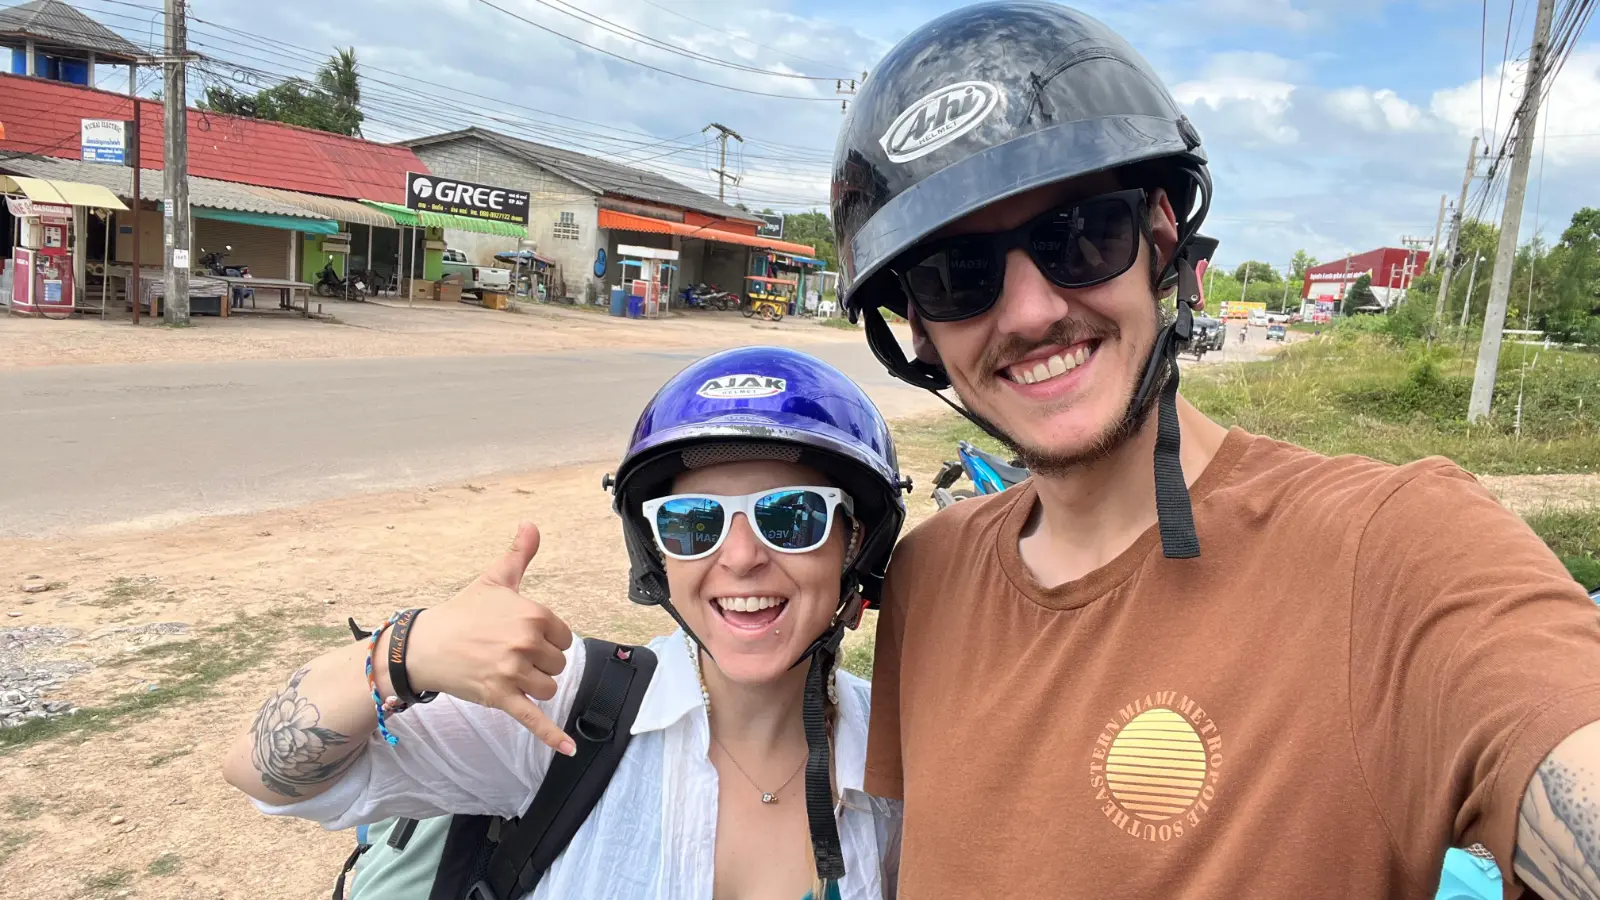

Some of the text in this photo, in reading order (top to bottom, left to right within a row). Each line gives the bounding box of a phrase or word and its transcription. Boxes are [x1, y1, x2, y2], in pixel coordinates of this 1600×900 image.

[101, 121, 122, 133] ELECTRIC
[919, 121, 957, 145] HELMET
[435, 181, 506, 210] GREE
[32, 204, 65, 214] GASOLINE
[700, 377, 784, 393] AJAK
[390, 632, 403, 663] What
[1089, 690, 1223, 842] SOUTHEASTERN MIAMI METROPOLE
